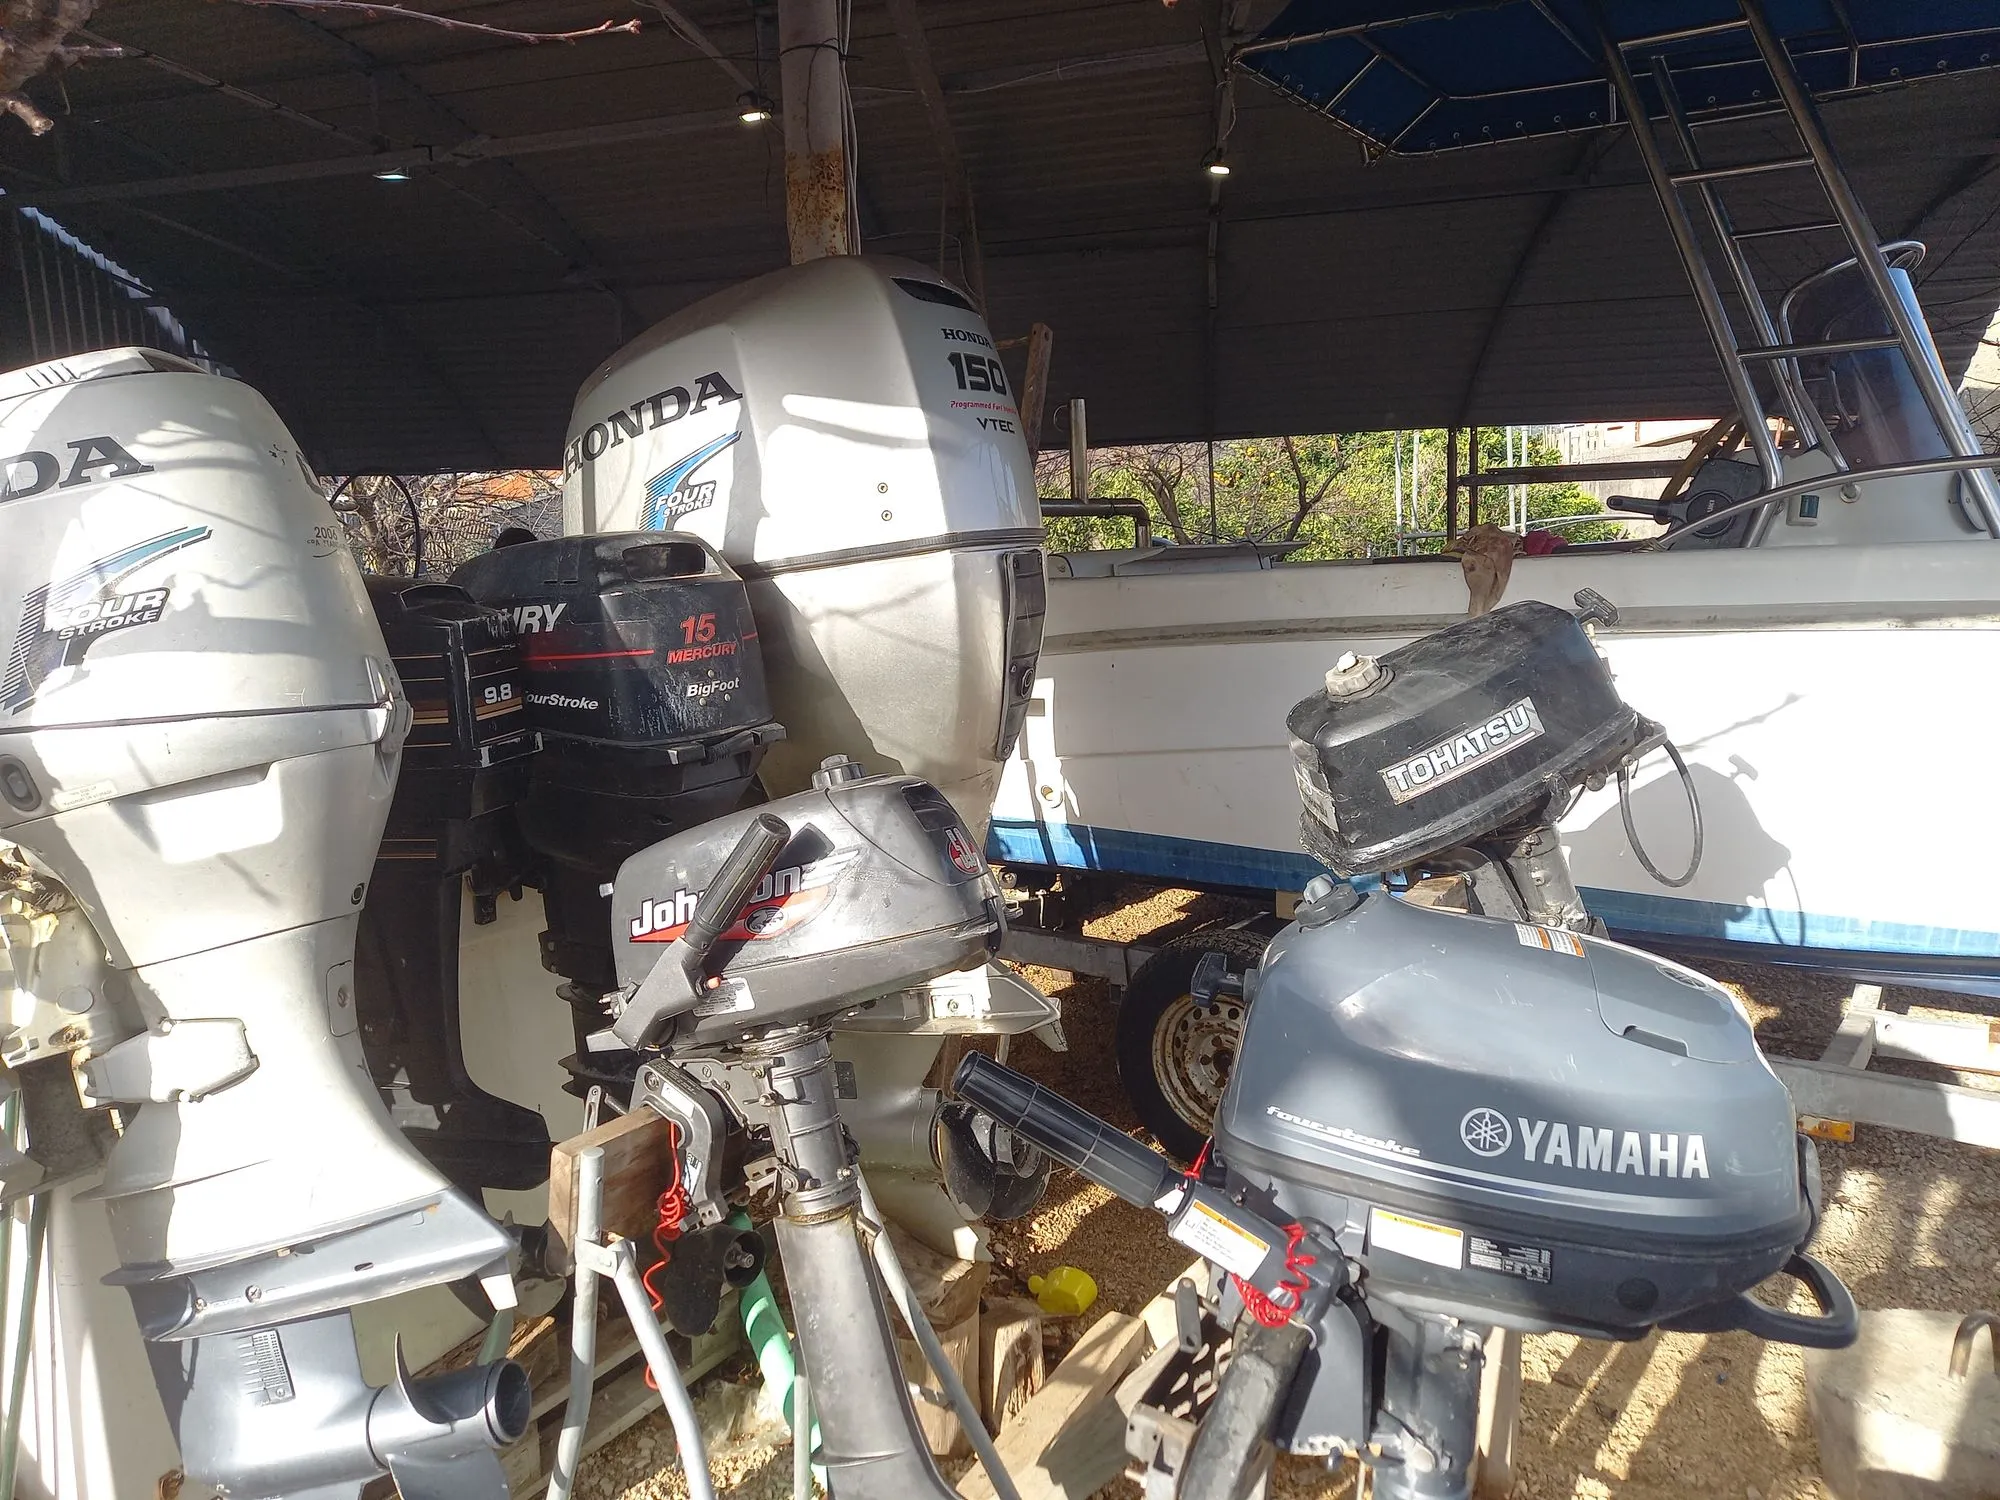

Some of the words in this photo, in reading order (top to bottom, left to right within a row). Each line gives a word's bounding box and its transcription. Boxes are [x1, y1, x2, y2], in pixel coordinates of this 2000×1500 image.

[941, 328, 993, 350] HONDA
[947, 351, 1007, 396] 150
[950, 400, 992, 411] Programmed
[564, 371, 743, 484] HONDA
[976, 417, 1015, 435] VTEC
[655, 481, 716, 512] FOUR
[662, 498, 712, 518] STROKE
[43, 589, 167, 633] FOUR
[57, 608, 159, 641] STROKE
[680, 612, 716, 645] 15
[666, 641, 737, 665] MERCURY
[484, 682, 513, 705] 9.8
[687, 676, 740, 698] BigFoot
[525, 693, 600, 711] ourStroke
[1386, 703, 1532, 793] TOHATSU
[1517, 1116, 1710, 1179] YAMAHA
